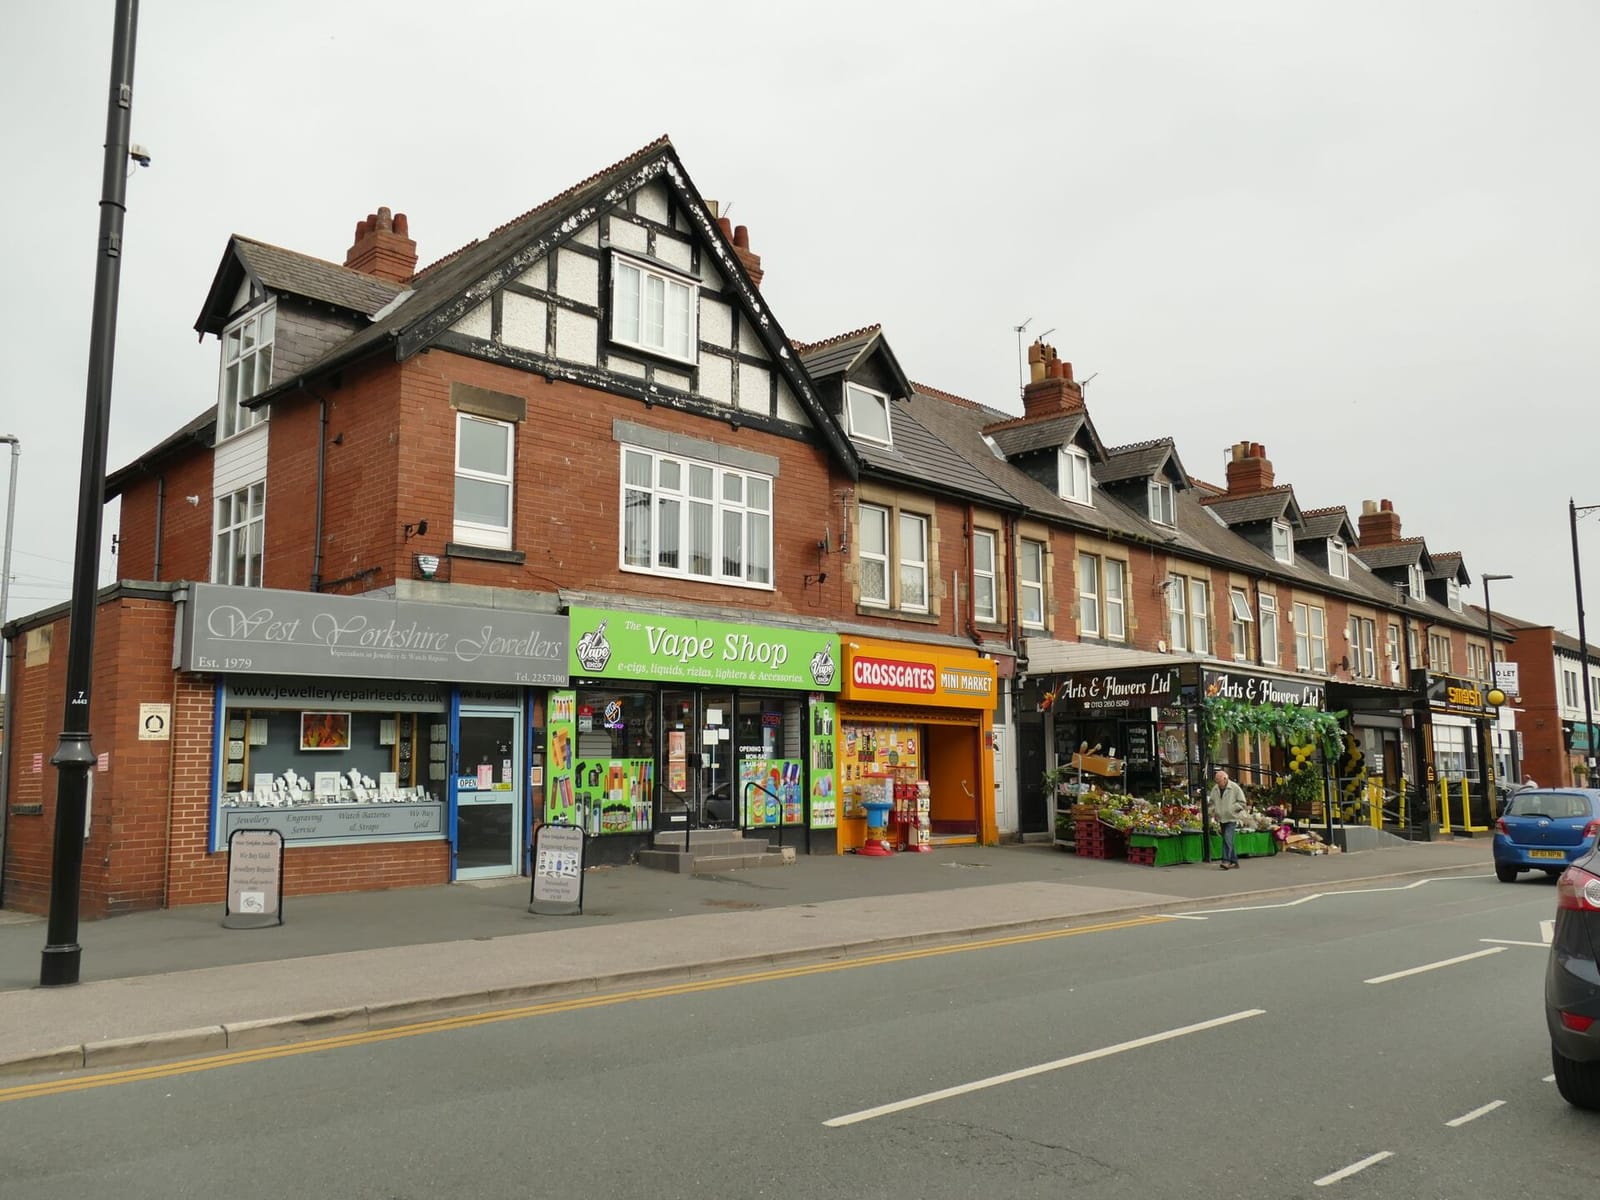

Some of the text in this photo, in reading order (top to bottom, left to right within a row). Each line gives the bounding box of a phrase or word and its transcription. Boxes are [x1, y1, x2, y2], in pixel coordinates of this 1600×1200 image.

[207, 604, 562, 662] West Yorkshire Jewellers
[578, 641, 610, 660] Vape
[624, 620, 789, 671] The Vape Shop
[199, 656, 252, 669] Est. 1979
[515, 672, 565, 683] Tel. 2257300
[651, 664, 684, 677] liquids,
[715, 668, 748, 680] lighters
[748, 672, 756, 680] &
[854, 662, 935, 690] CROSSGATES
[941, 673, 992, 692] MINI MARKET
[1061, 672, 1171, 700] Arts & Flowers Ltd
[1216, 674, 1319, 707] Arts & Flowers Ltd
[78, 691, 85, 699] 7
[235, 815, 270, 825] Jewellery
[287, 814, 322, 823] Engraving
[339, 811, 360, 820] Watch
[292, 826, 317, 834] Service
